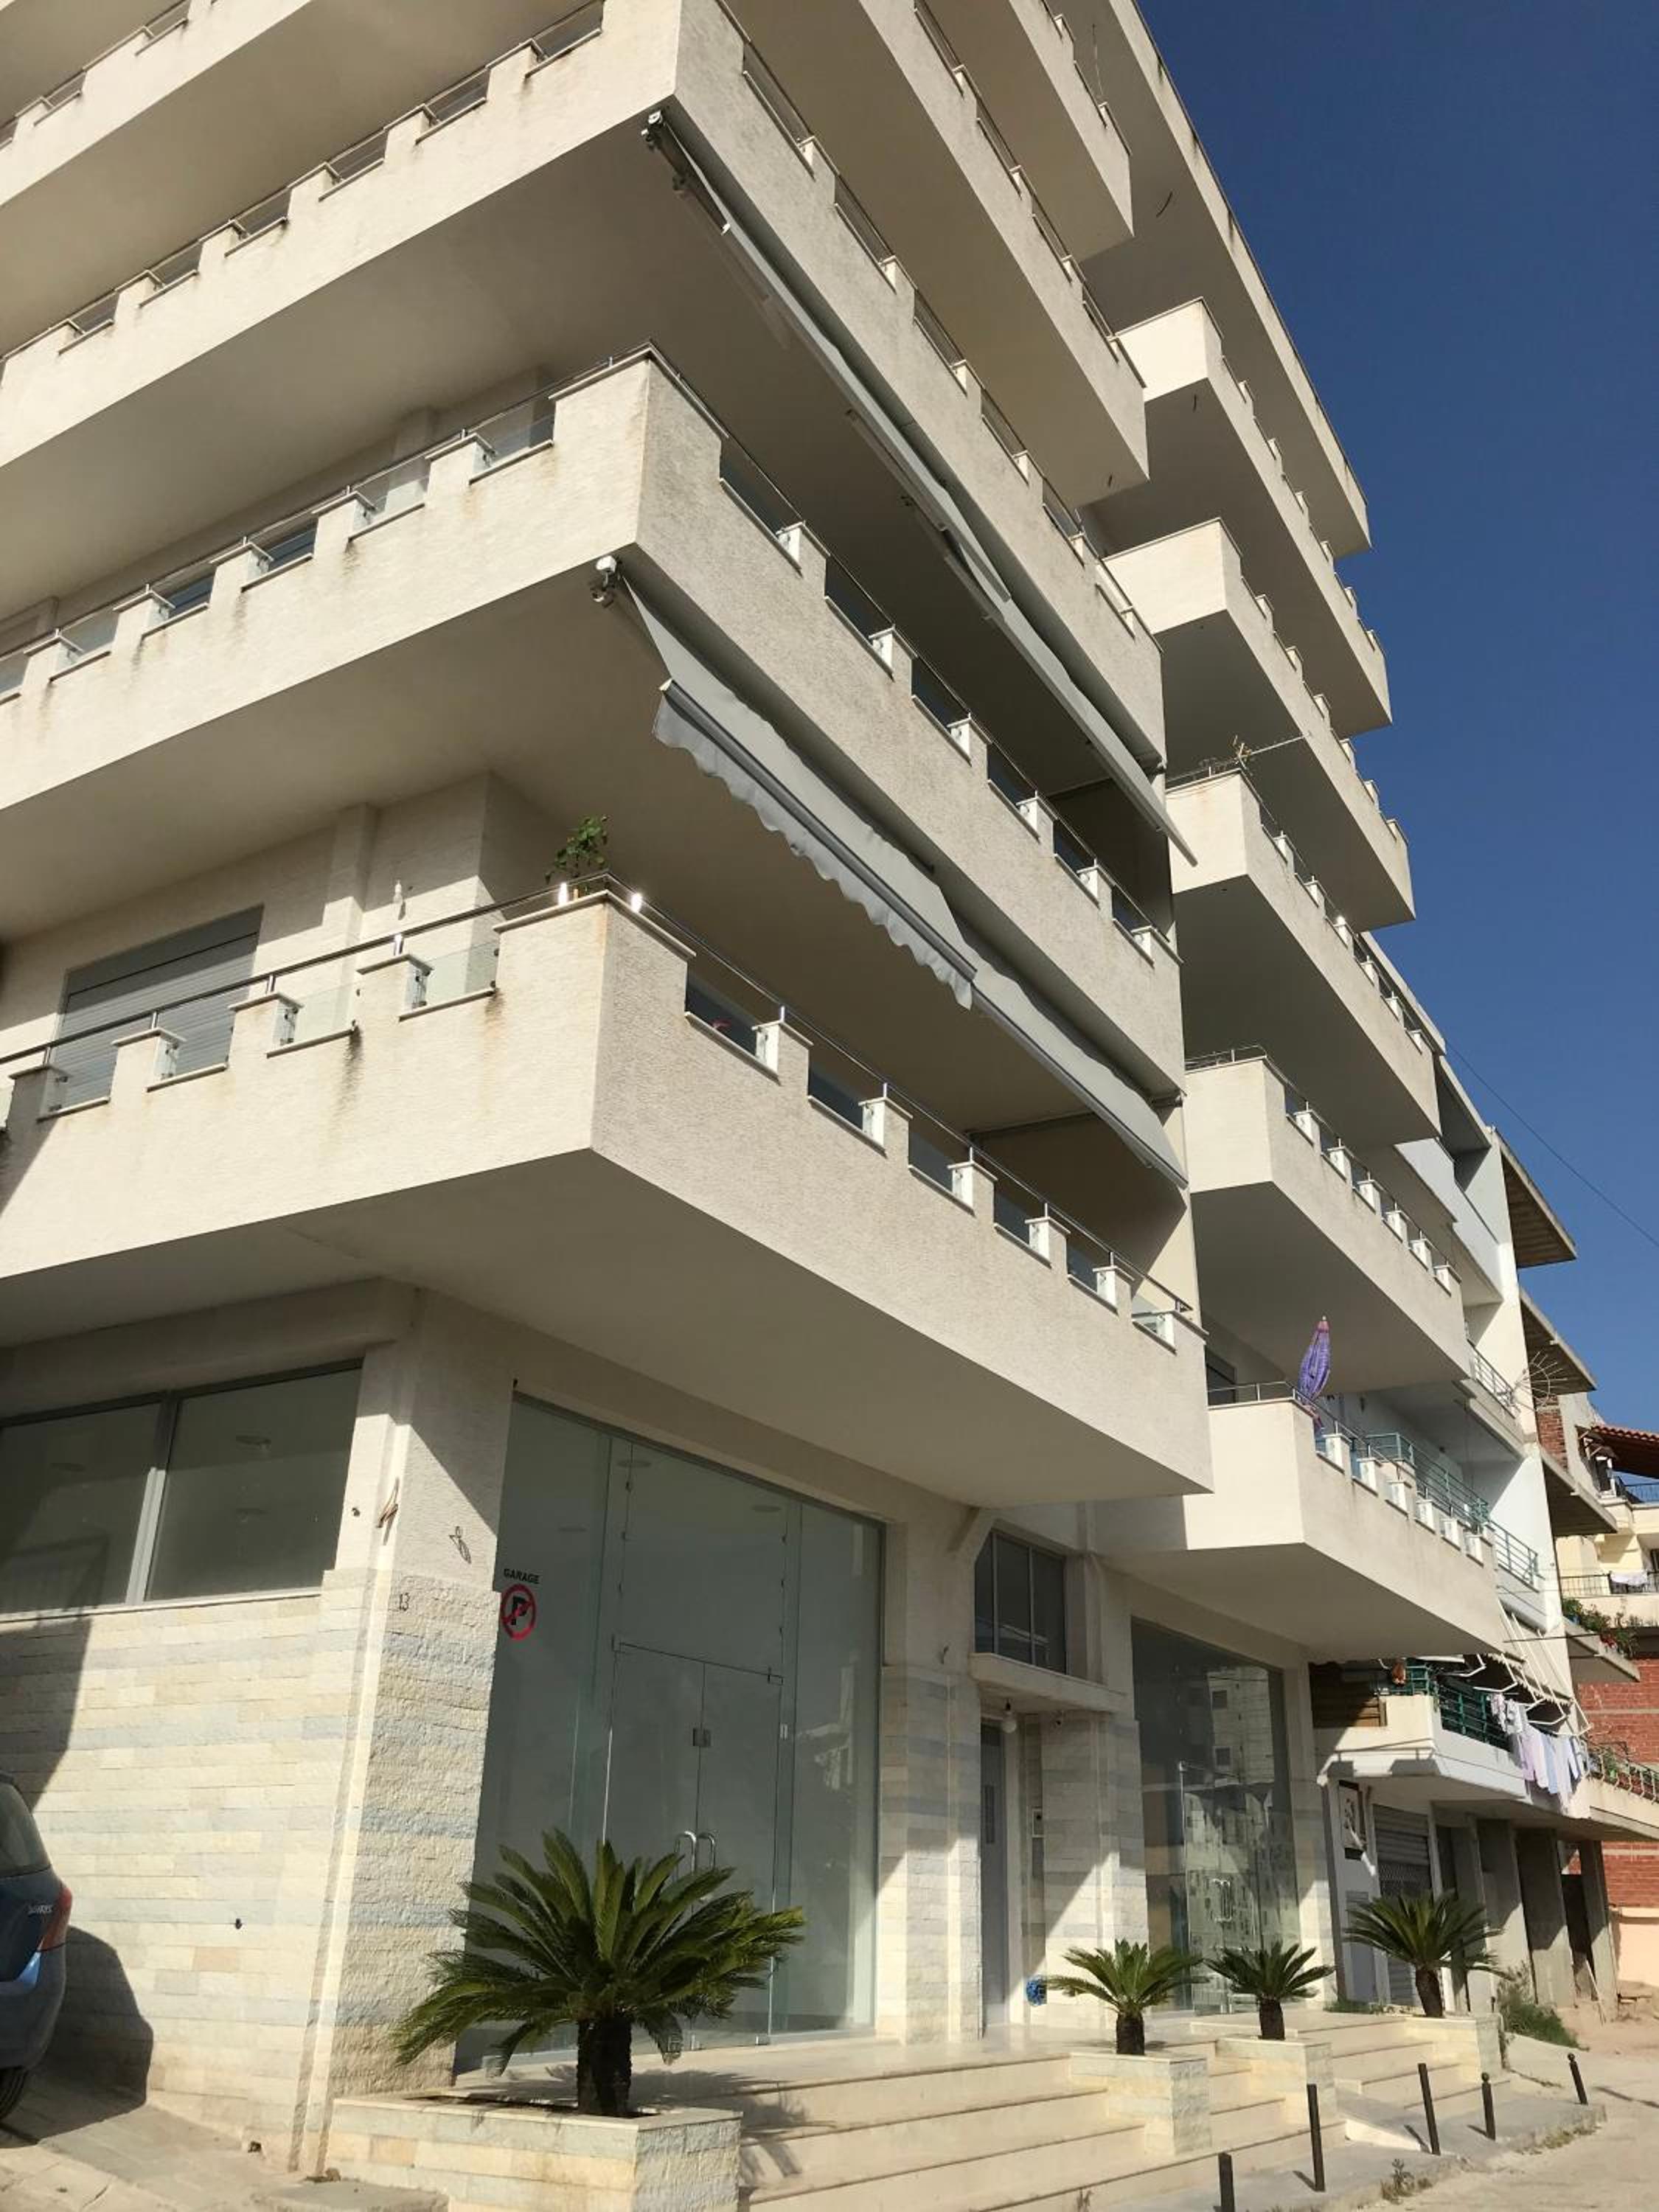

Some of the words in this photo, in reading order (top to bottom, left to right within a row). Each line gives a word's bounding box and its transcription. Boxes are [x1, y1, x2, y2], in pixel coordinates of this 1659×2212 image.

[504, 1568, 540, 1584] GARAGE
[399, 1593, 411, 1612] 13
[511, 1596, 528, 1625] P
